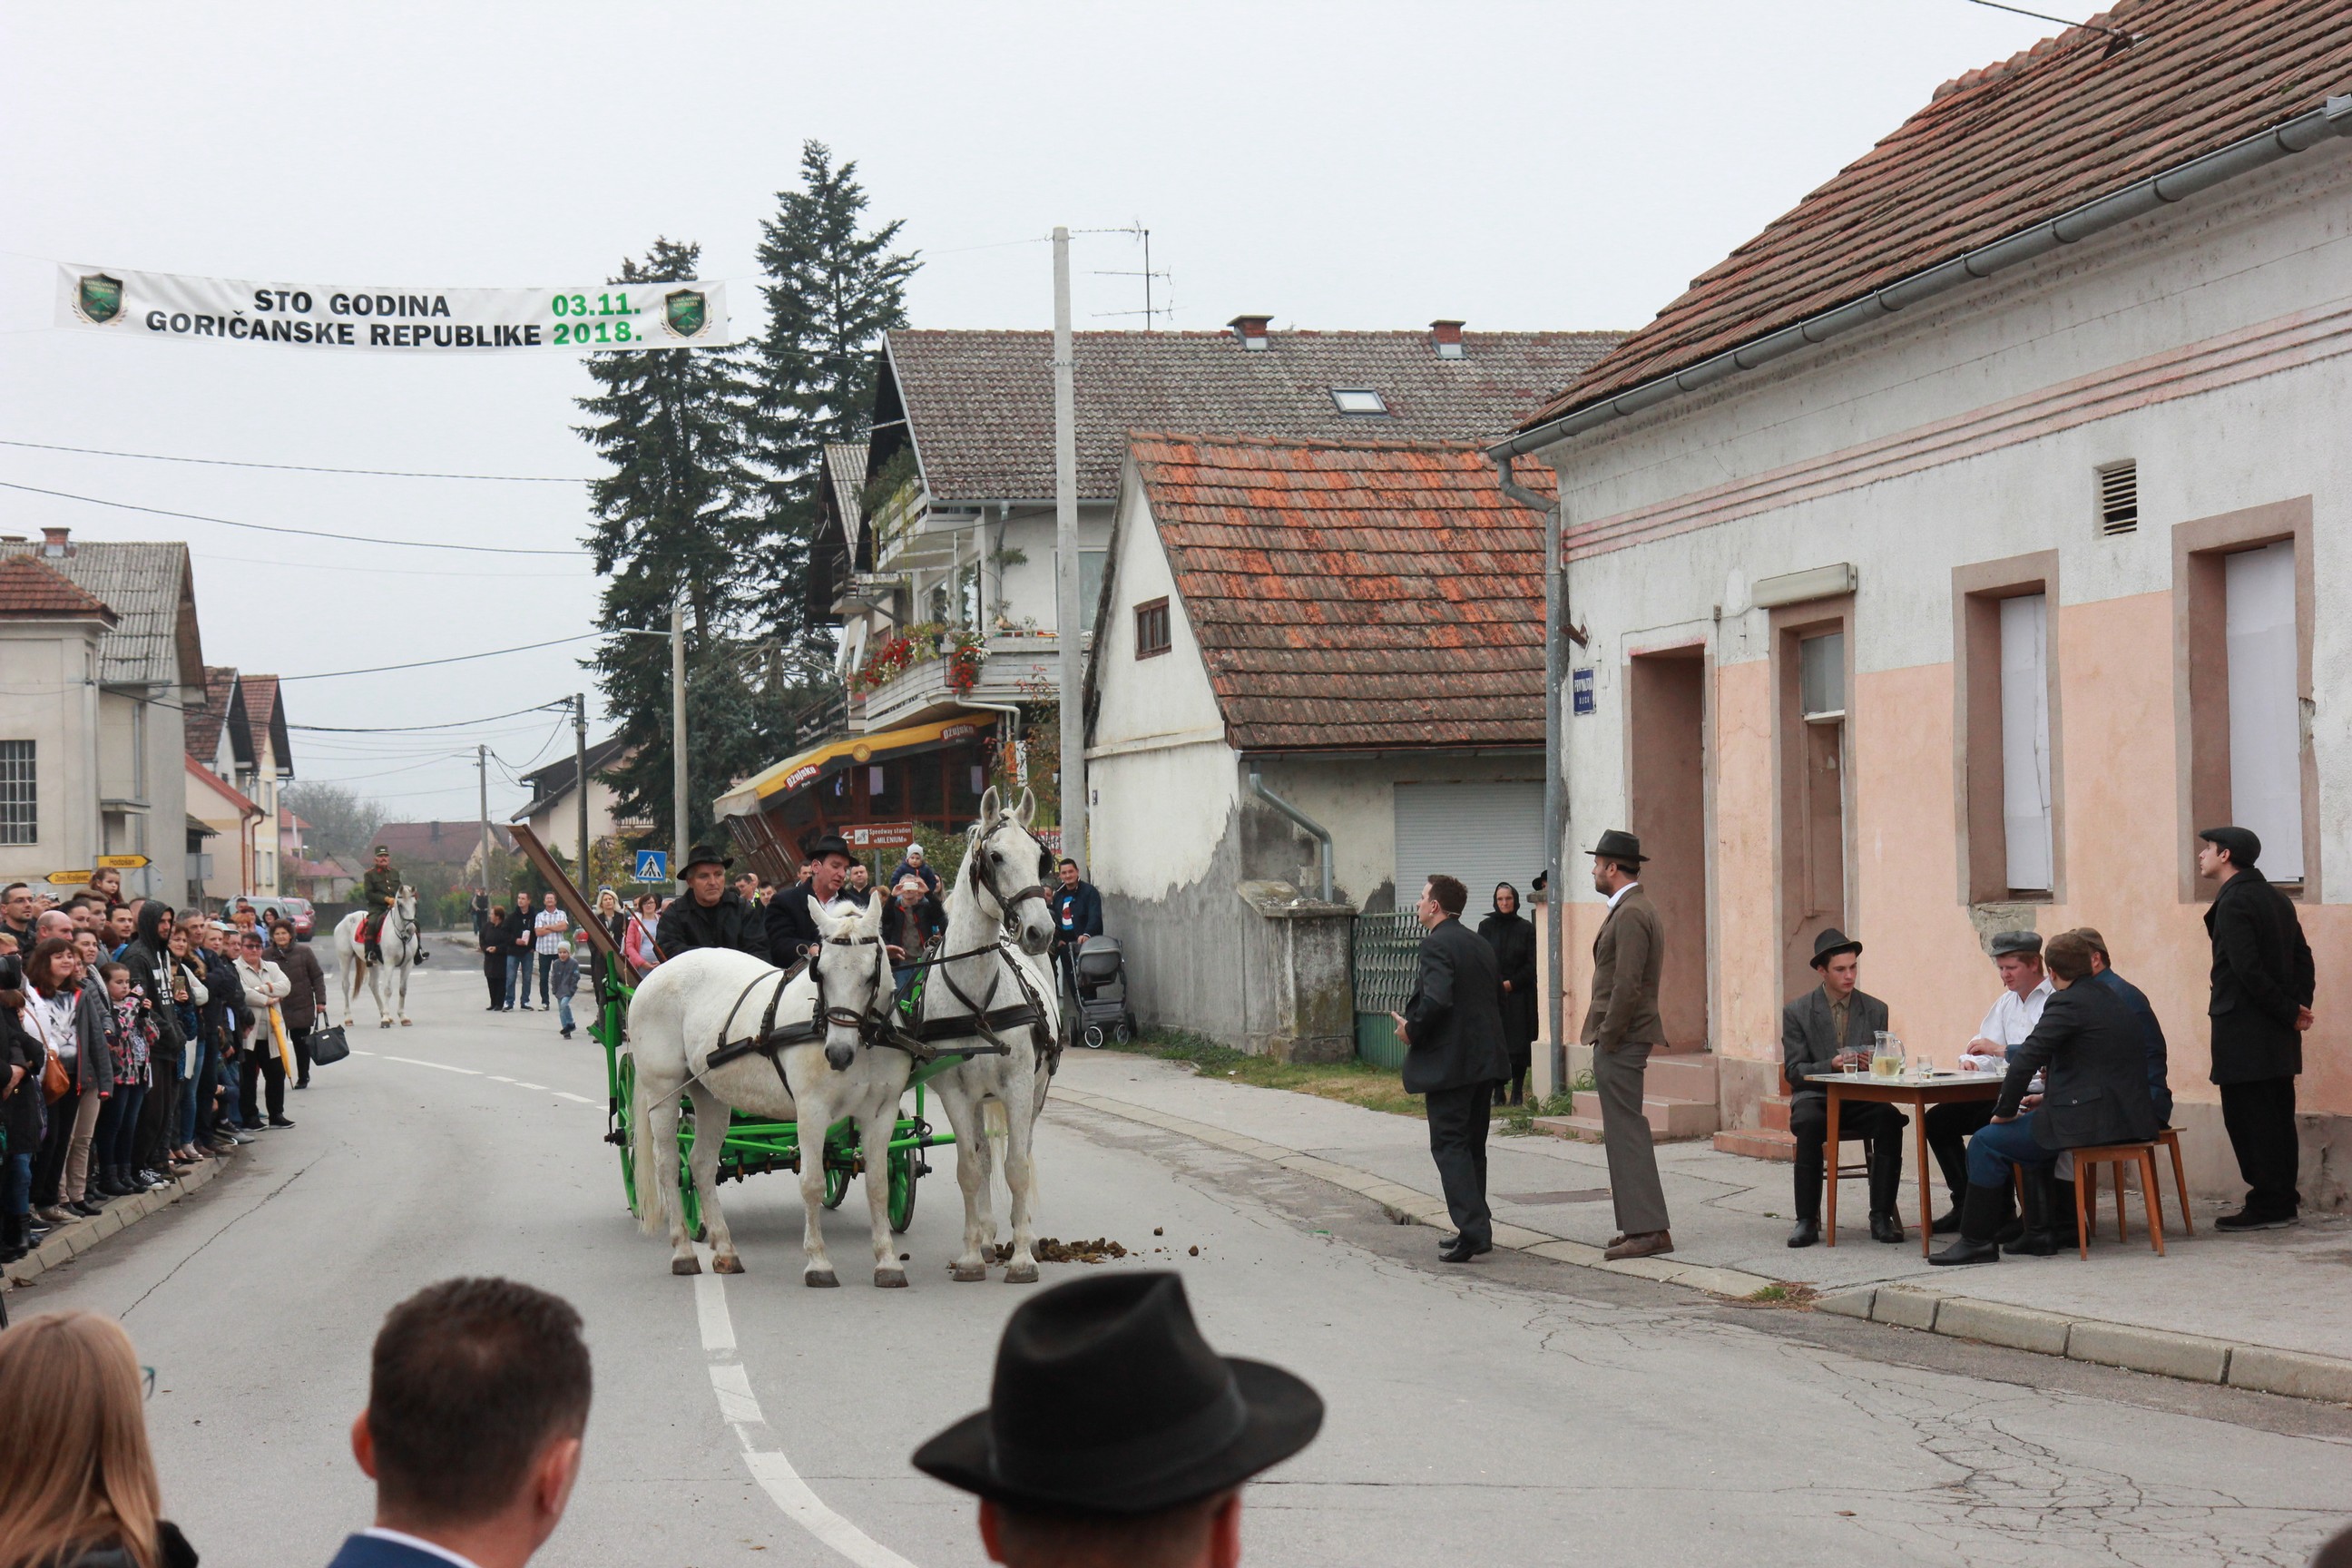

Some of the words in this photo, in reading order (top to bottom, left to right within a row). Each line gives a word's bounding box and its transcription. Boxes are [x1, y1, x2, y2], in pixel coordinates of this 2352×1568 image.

[254, 289, 312, 313] STO
[329, 293, 451, 317] GODINA
[552, 293, 641, 316] 03.11.
[146, 310, 355, 346] GORIČANSKE
[370, 324, 542, 347] REPUBLIKE
[553, 321, 642, 345] 2018.
[868, 828, 893, 837] Speedway
[894, 827, 911, 835] stadion
